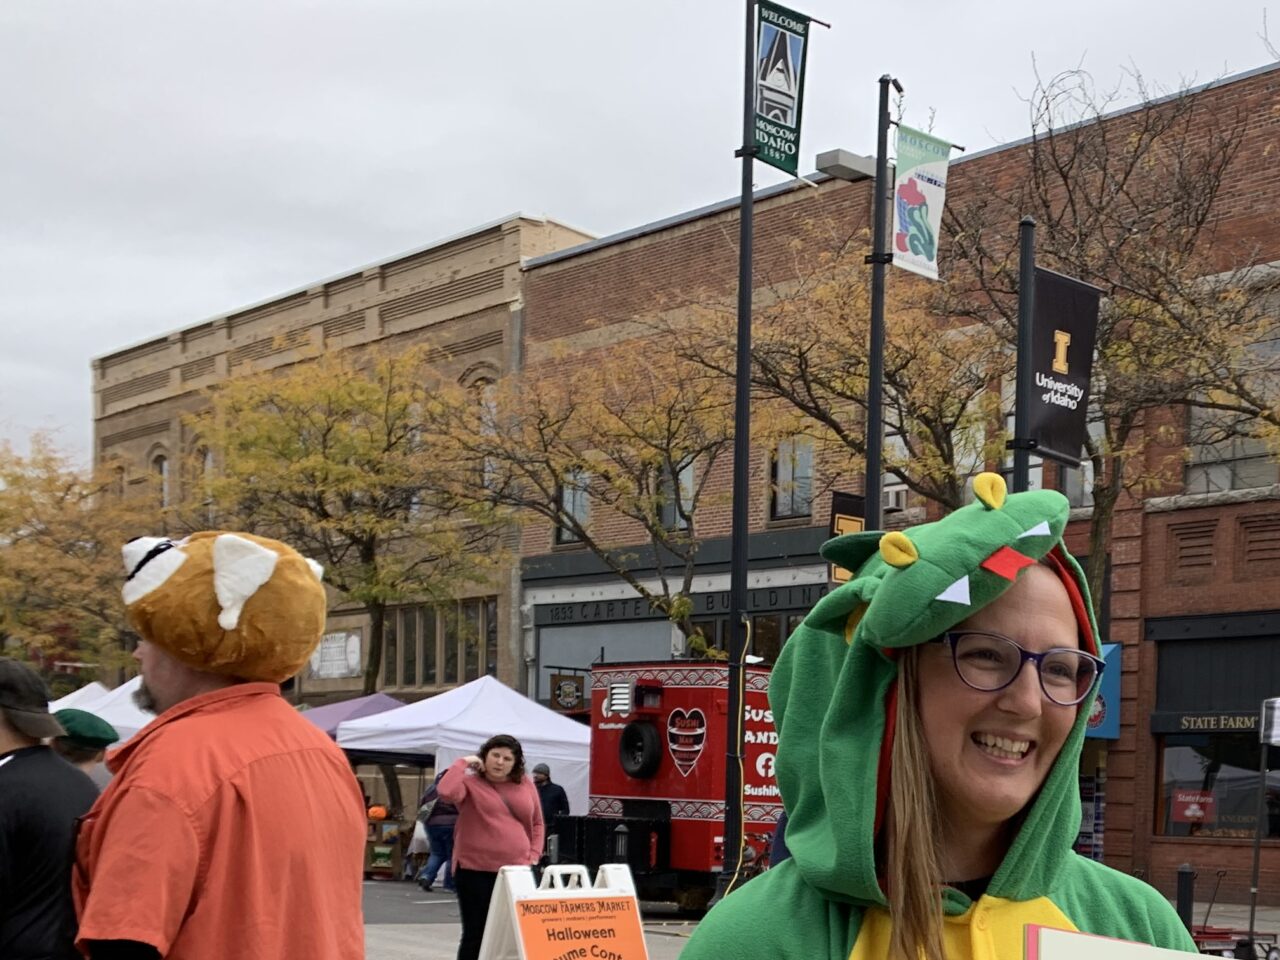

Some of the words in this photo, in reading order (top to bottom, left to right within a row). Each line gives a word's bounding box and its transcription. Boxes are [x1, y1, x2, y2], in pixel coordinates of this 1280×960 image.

[761, 8, 806, 34] WELCOME
[756, 117, 797, 142] MOSCOW
[755, 128, 796, 155] IDAHO
[898, 132, 951, 158] MOSCOW
[764, 146, 786, 162] 1887
[1036, 371, 1084, 402] University
[1042, 391, 1051, 404] of
[1050, 390, 1078, 410] Idaho
[675, 717, 700, 729] SUSHI
[1181, 715, 1218, 730] STATE
[520, 902, 559, 917] MOSCOW
[558, 900, 597, 915] FARMERS
[597, 900, 631, 914] MARKET
[546, 926, 616, 942] Halloween
